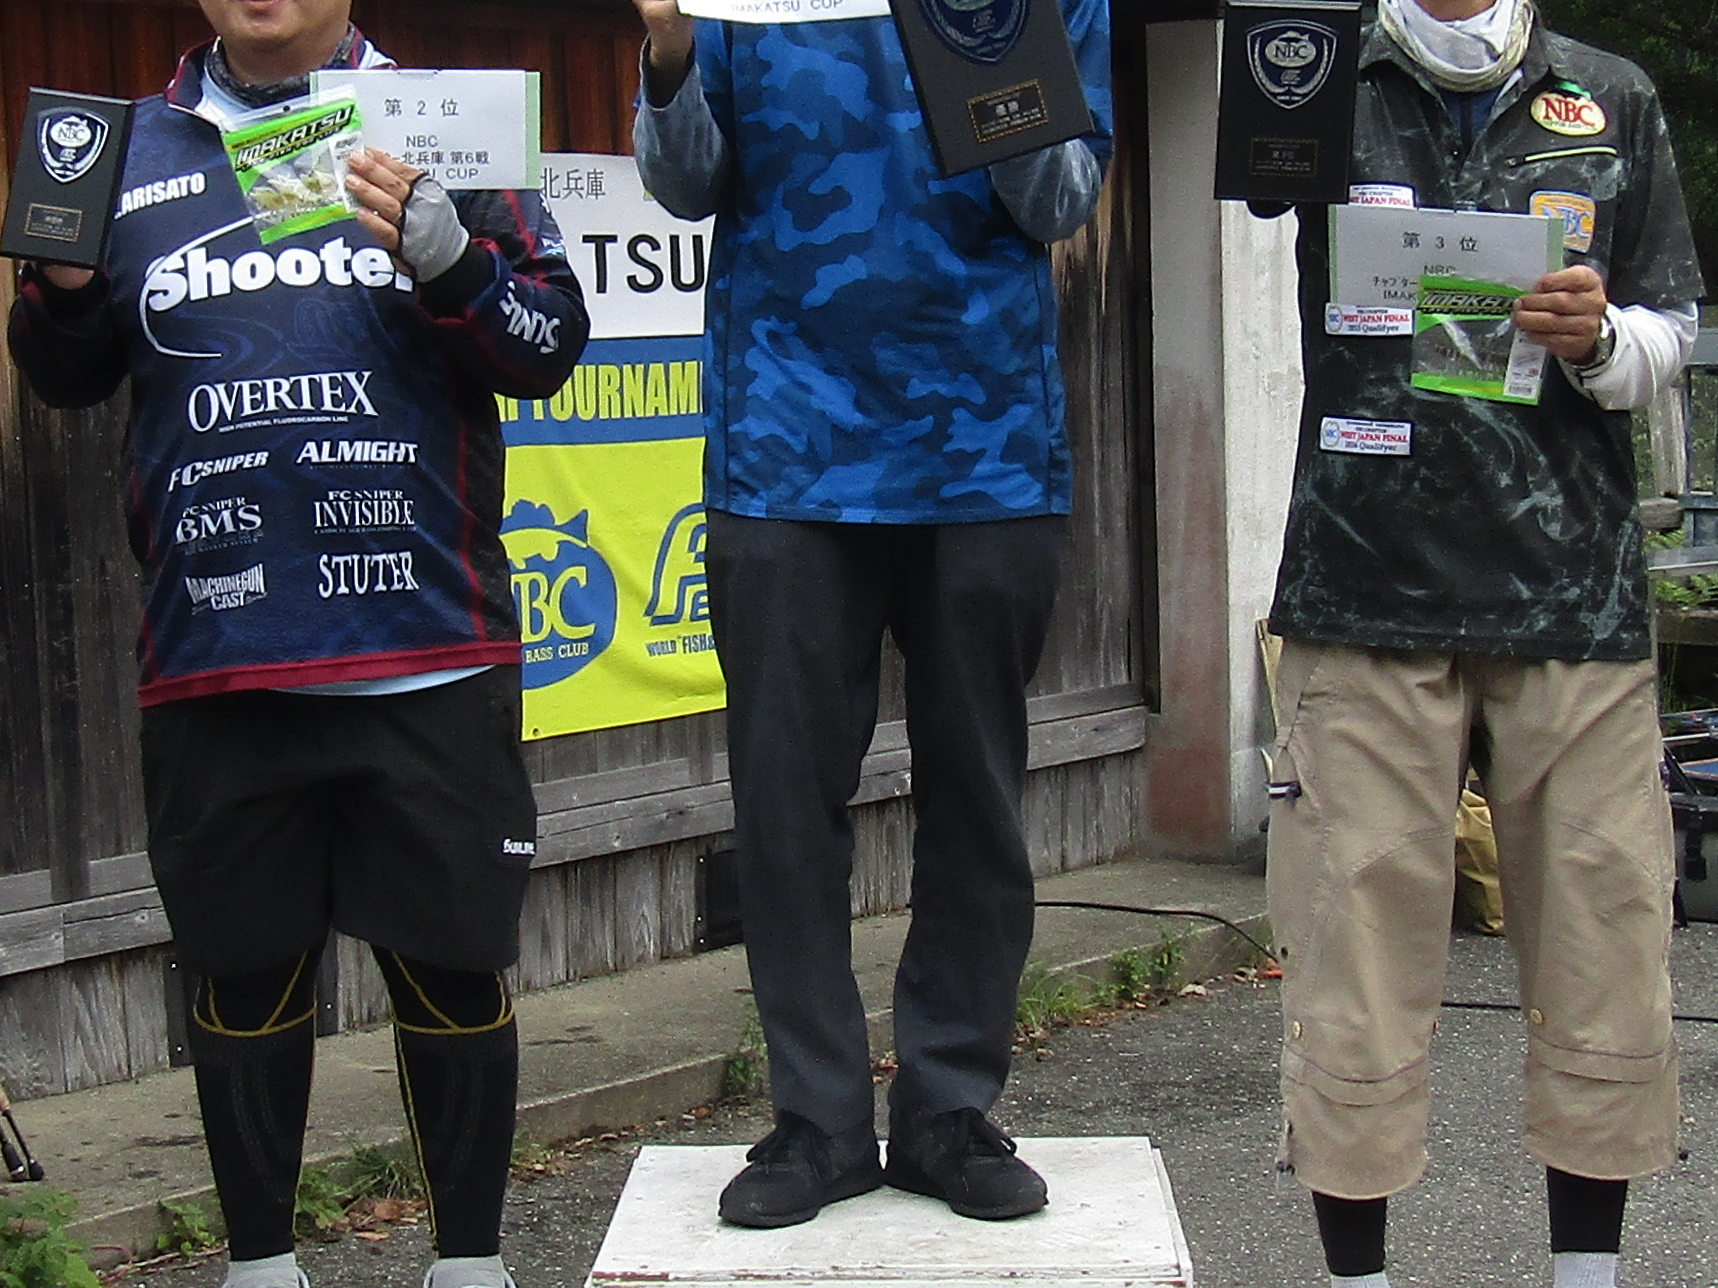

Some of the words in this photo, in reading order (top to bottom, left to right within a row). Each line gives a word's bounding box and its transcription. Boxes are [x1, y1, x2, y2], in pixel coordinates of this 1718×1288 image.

[1273, 44, 1308, 60] NBC
[1542, 98, 1595, 127] NBC
[57, 125, 87, 142] NBC
[237, 105, 354, 167] IMAKATSU
[405, 135, 438, 149] NBC
[450, 150, 491, 166] 第6戦
[446, 167, 480, 180] CUP
[188, 370, 378, 433] OVERTEX
[297, 441, 419, 463] ALMIGHT
[354, 489, 404, 501] SNIPER
[176, 504, 263, 544] BMS
[314, 500, 415, 528] INVISIBLE
[185, 563, 264, 605] MACHINEGUN
[319, 551, 419, 600] STUTER
[210, 591, 245, 611] CAST
[511, 566, 596, 644] BC
[525, 647, 554, 664] BASS
[557, 642, 590, 658] CLUB
